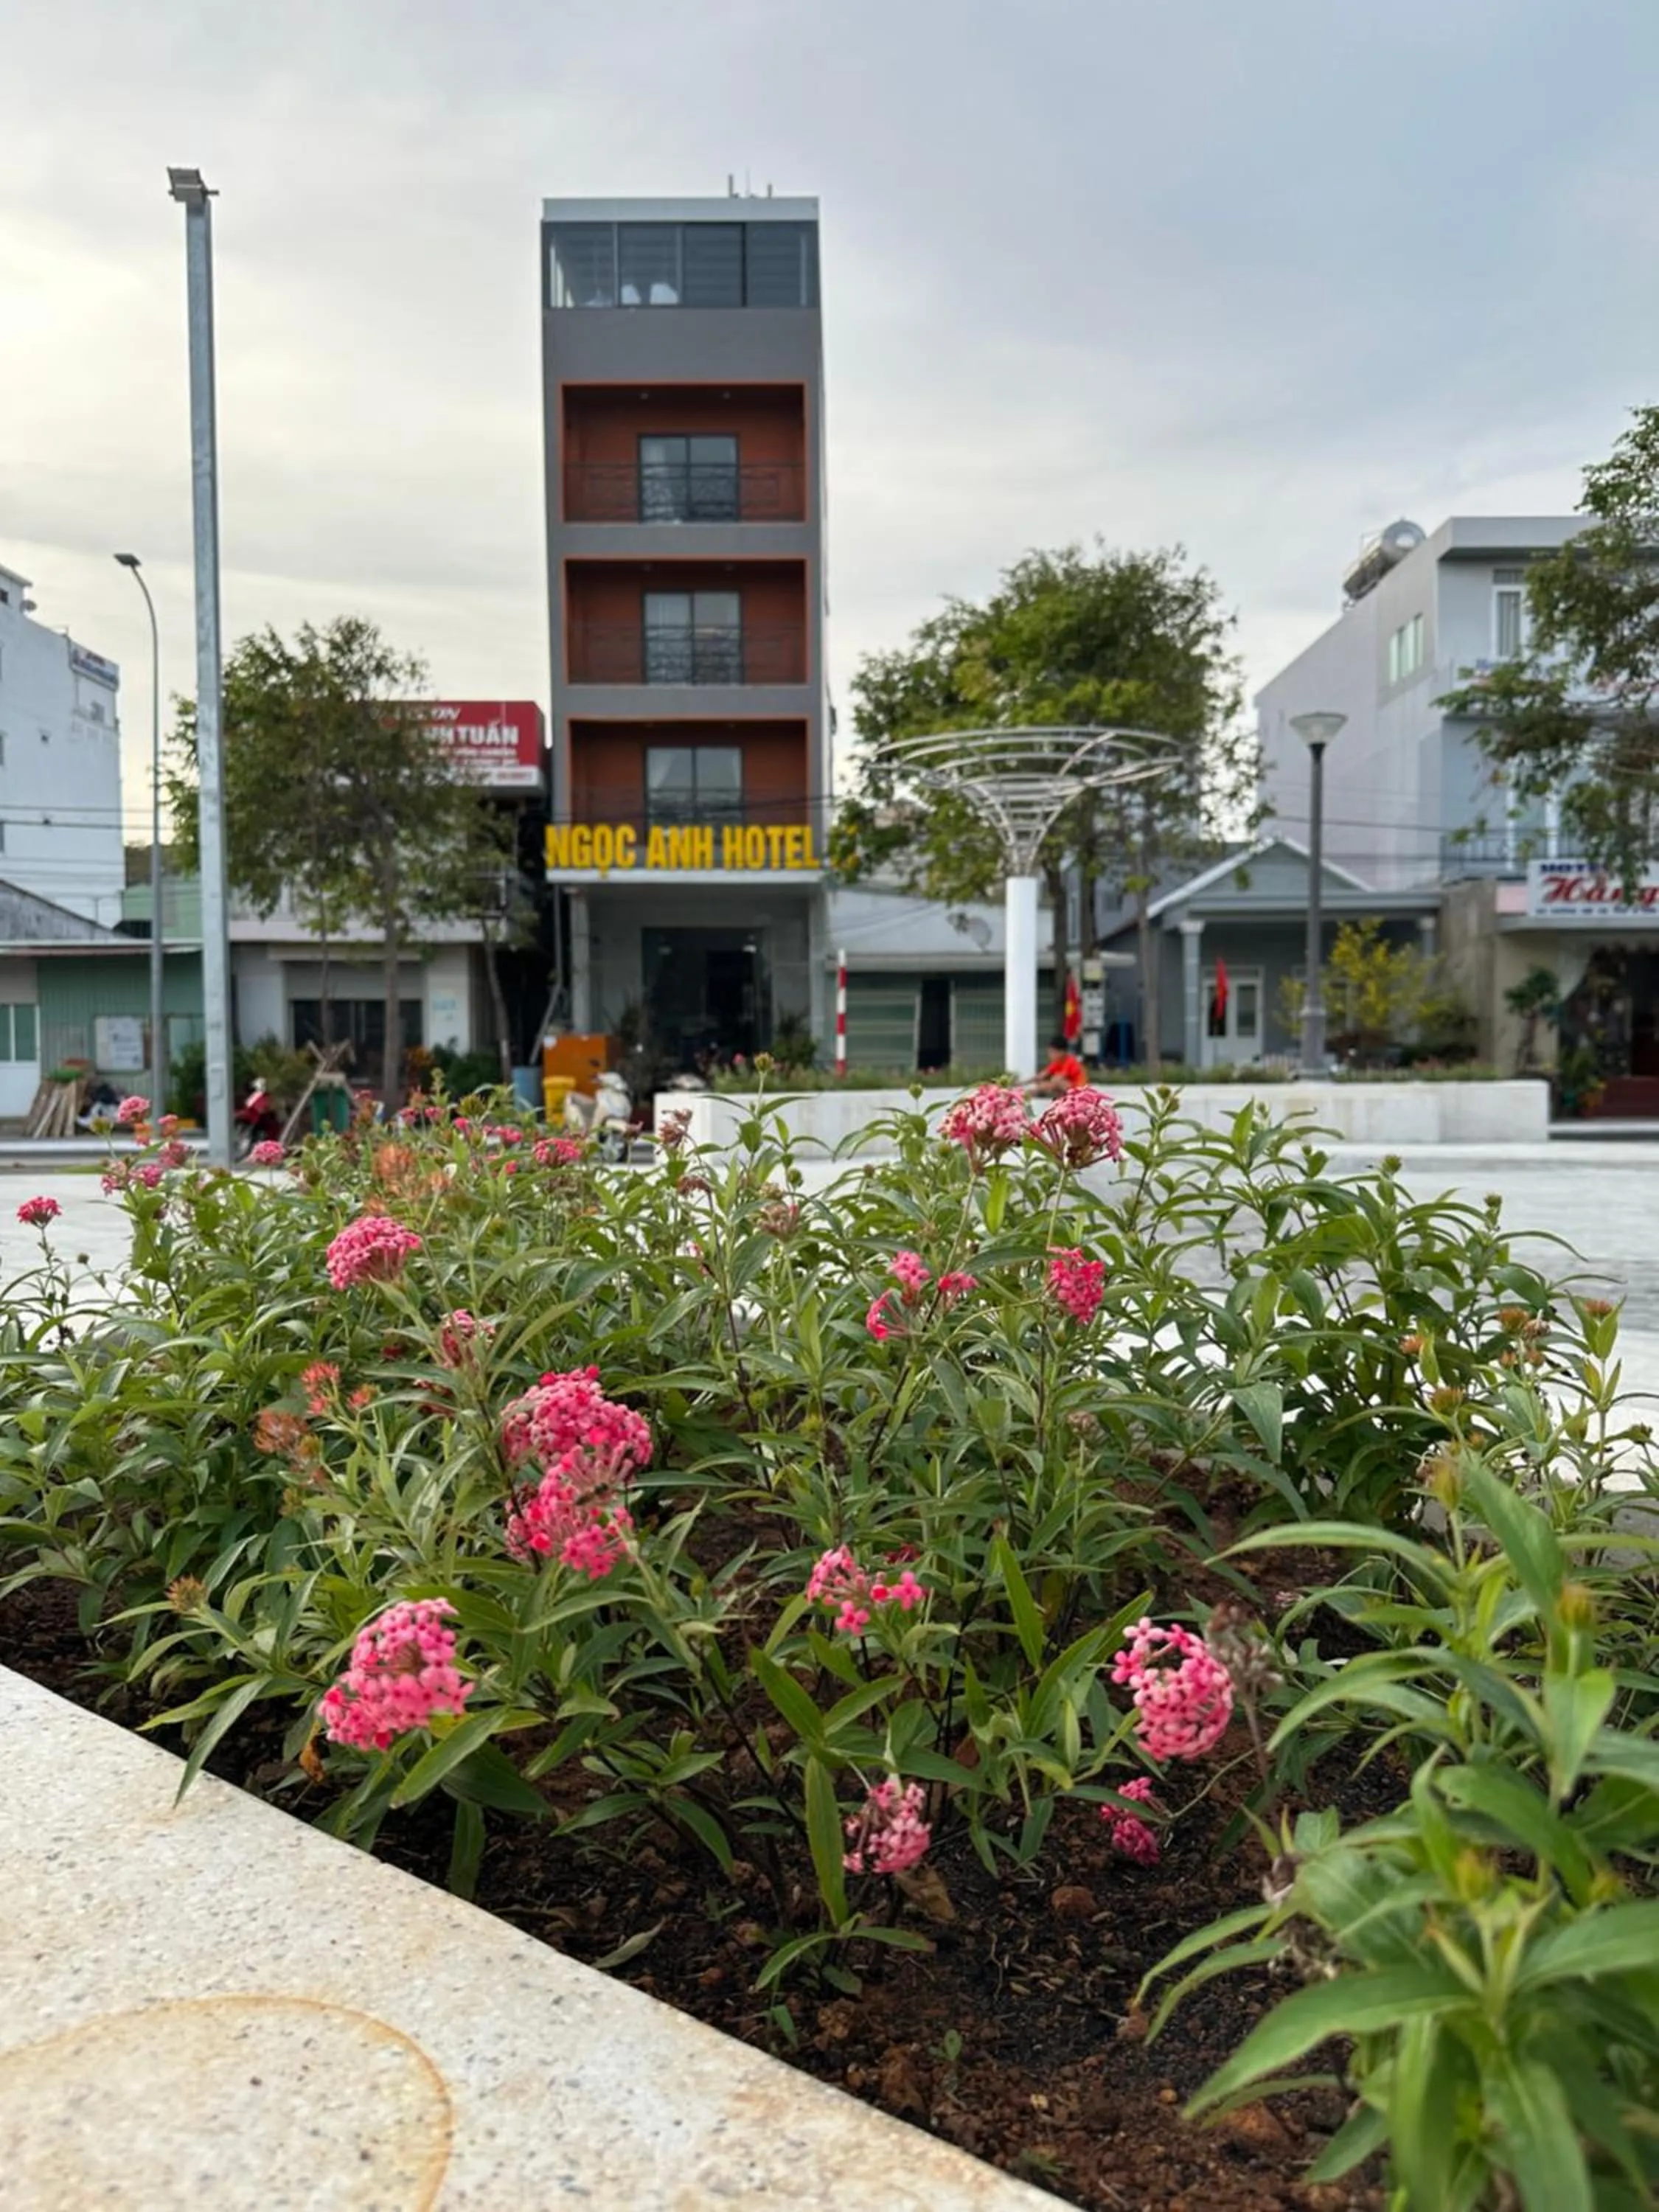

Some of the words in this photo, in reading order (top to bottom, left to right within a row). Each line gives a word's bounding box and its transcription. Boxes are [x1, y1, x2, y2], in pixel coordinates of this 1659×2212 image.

[457, 717, 519, 745] TUẤN
[544, 823, 637, 879] NGỌC
[646, 824, 714, 870] ANH
[722, 824, 820, 870] HOTEL
